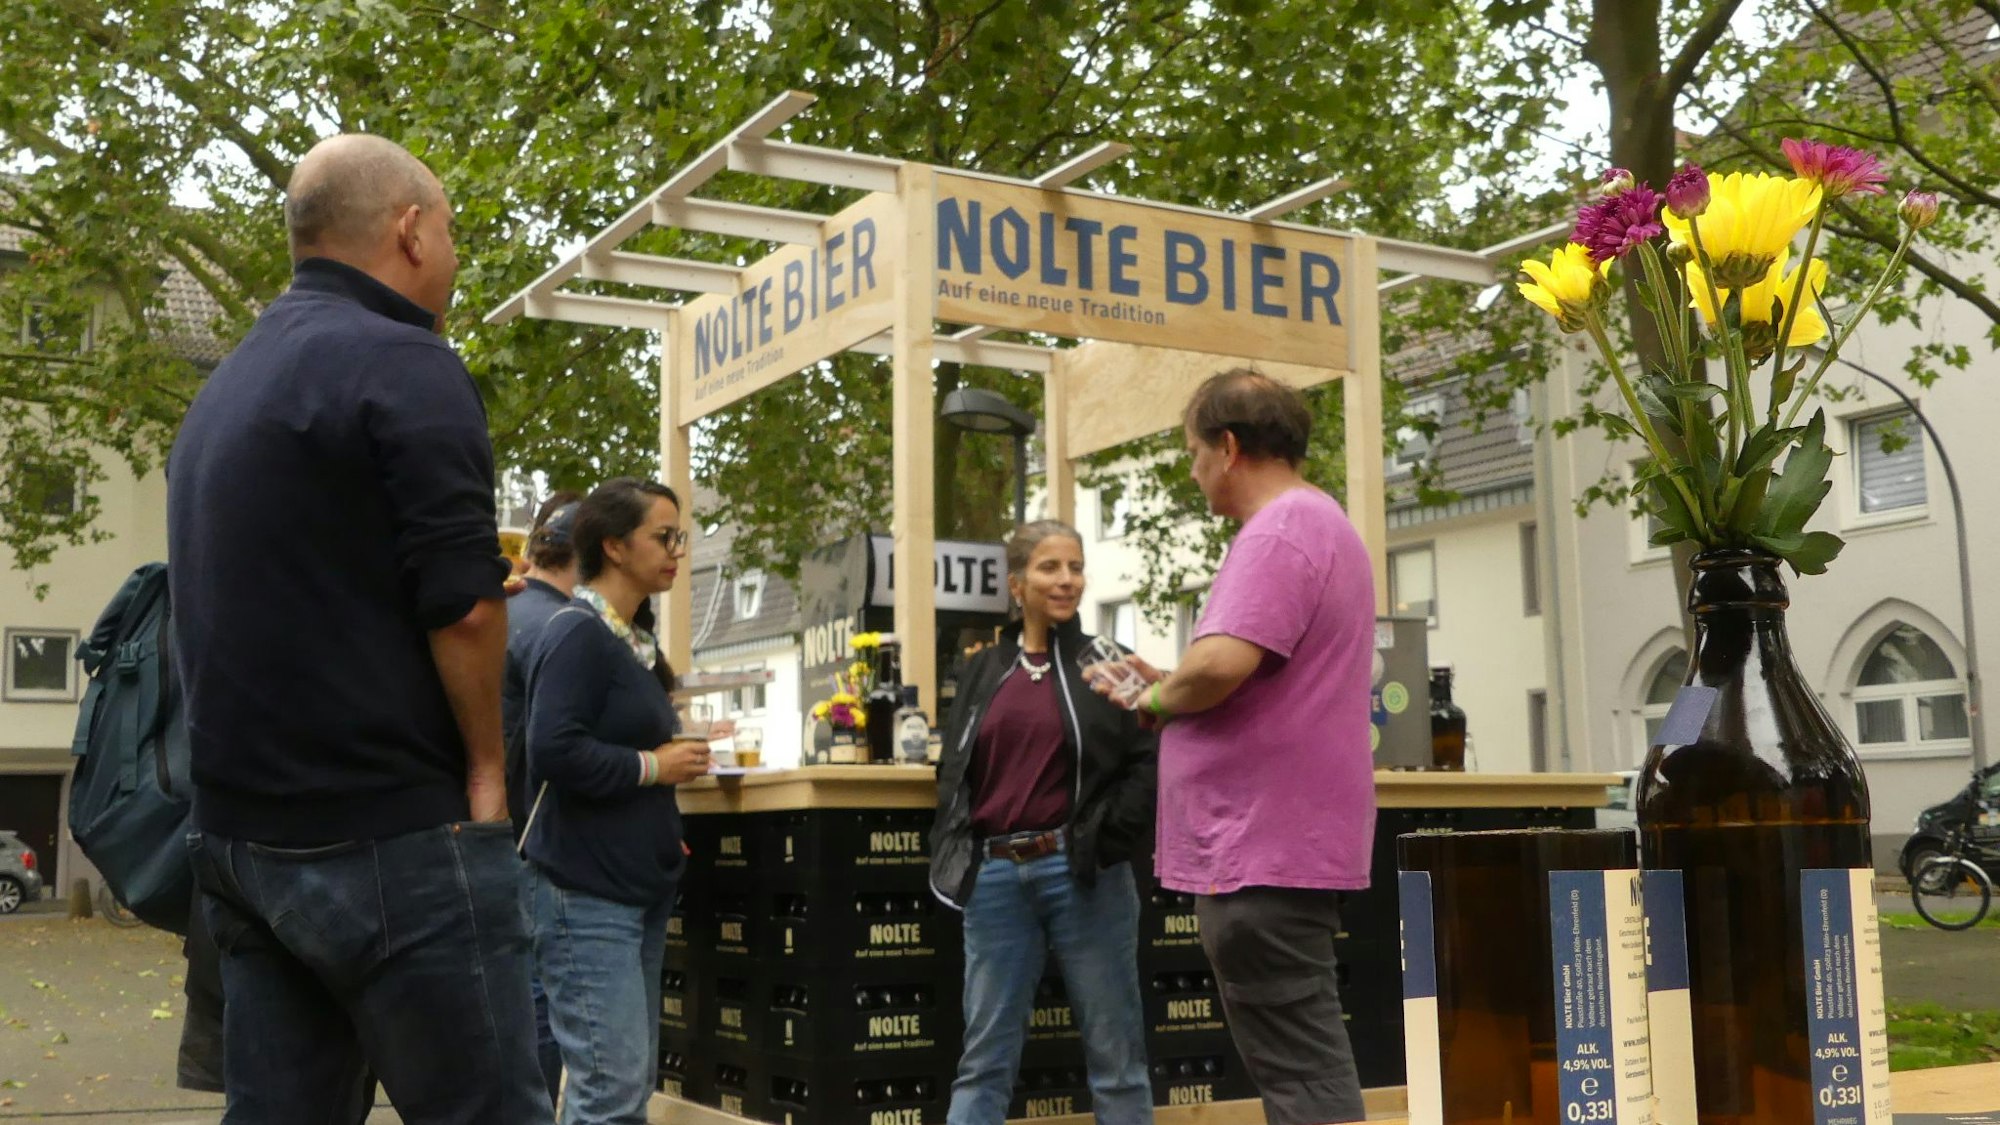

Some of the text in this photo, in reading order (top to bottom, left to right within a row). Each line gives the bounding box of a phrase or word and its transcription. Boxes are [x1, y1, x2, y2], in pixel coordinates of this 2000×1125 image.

[937, 197, 1343, 326] NOLTE BIER
[694, 217, 876, 381] NOLTE BIER
[938, 279, 1166, 325] Auf eine neue Tradition
[888, 552, 999, 596] LTE
[804, 615, 855, 668] NOLTE
[870, 831, 921, 852] NOLTE
[870, 923, 921, 944] NOLTE
[1165, 914, 1200, 934] NOLT
[1563, 964, 1573, 1029] NOLTE Bier GmbH
[1815, 981, 1823, 996] Bier
[1167, 999, 1212, 1019] NOLTE
[1816, 996, 1824, 1020] NOLTE
[869, 1014, 920, 1038] NOLTE
[1576, 1043, 1599, 1055] ALK.
[1827, 1032, 1848, 1044] ALK.
[1815, 1048, 1840, 1060] 4,9%
[1840, 1047, 1859, 1058] VOL.
[1563, 1058, 1612, 1072] 4,9% VOL.
[1168, 1084, 1213, 1106] NOLTE
[1819, 1085, 1861, 1108] 0,33l
[871, 1108, 922, 1125] NOLTE
[1026, 1096, 1073, 1118] NOLTE
[1567, 1099, 1613, 1123] 0,33l
